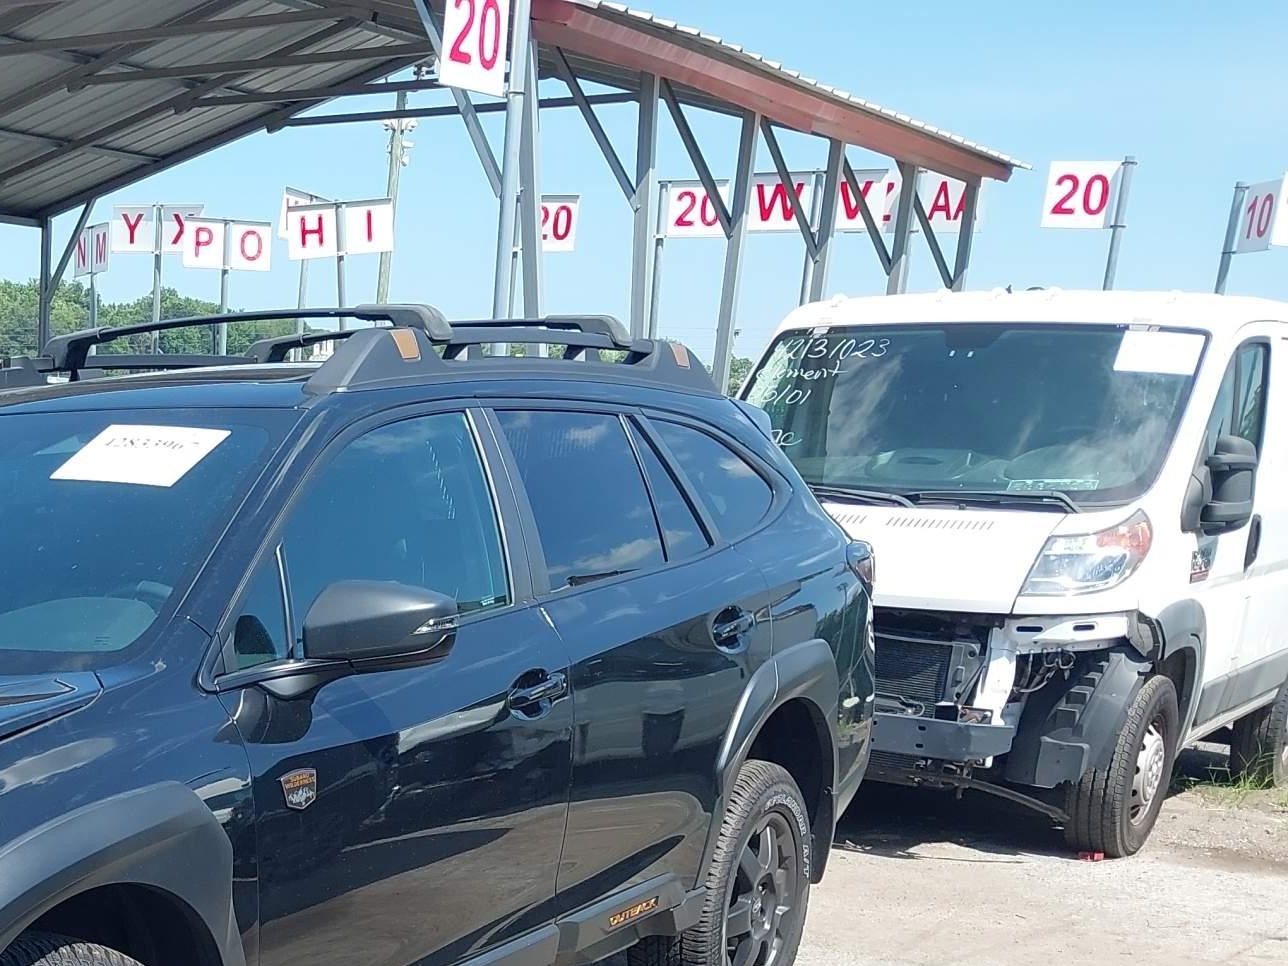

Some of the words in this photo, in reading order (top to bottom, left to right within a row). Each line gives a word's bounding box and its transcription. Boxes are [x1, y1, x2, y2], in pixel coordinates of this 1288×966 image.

[449, 0, 501, 71] 20
[673, 190, 719, 227] 20
[756, 182, 805, 222] W
[1050, 173, 1110, 216] 20
[121, 212, 145, 245] Y
[299, 212, 324, 249] H
[1246, 192, 1274, 240] 10
[95, 231, 107, 265] M
[194, 226, 214, 258] P
[240, 230, 263, 262] O
